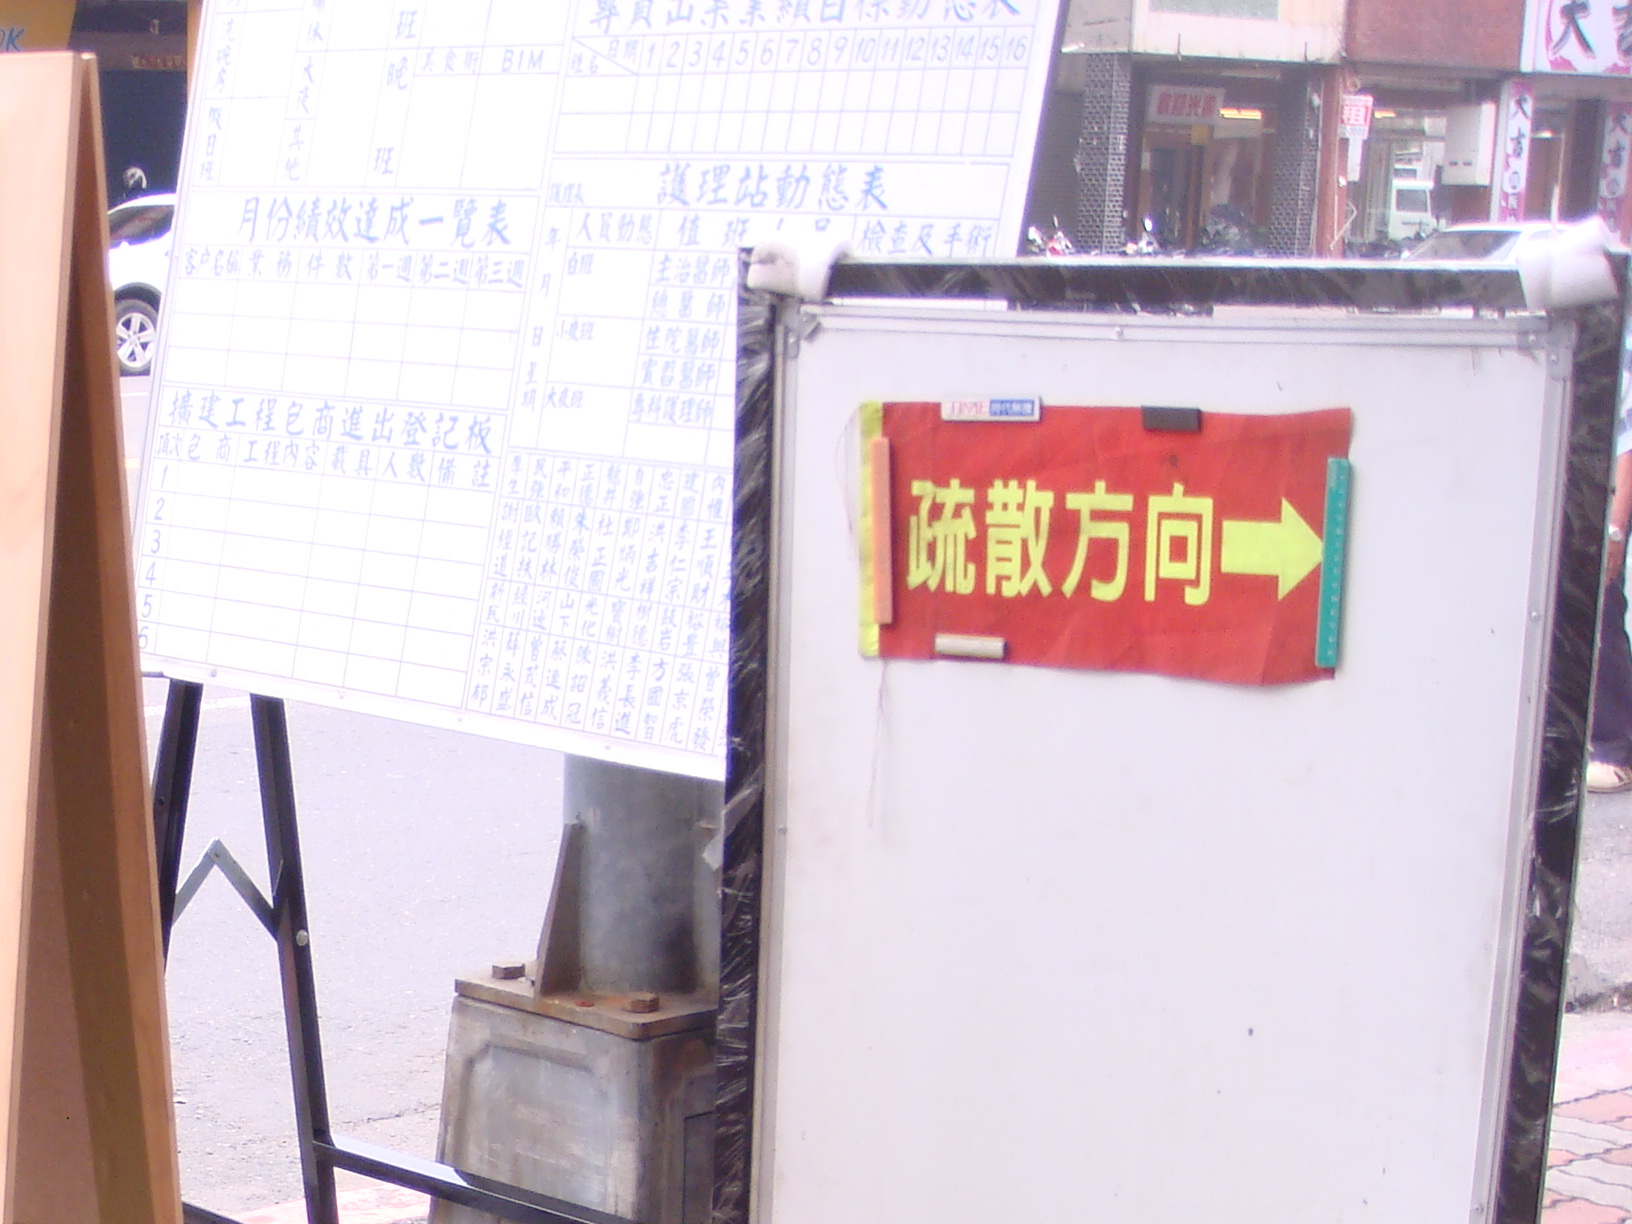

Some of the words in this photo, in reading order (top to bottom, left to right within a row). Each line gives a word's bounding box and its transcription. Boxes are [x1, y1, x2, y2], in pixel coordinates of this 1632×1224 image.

[607, 39, 639, 63] 日期
[647, 42, 656, 69] 1
[666, 40, 680, 68] 2
[688, 41, 703, 67] 3
[712, 40, 726, 67] 4
[735, 39, 751, 66] 5
[760, 39, 774, 66] 6
[787, 38, 800, 63] 7
[807, 37, 822, 66] 8
[834, 36, 848, 63] 9
[855, 36, 876, 63] 10
[881, 37, 900, 62] 11
[905, 36, 925, 62] 12
[930, 35, 951, 62] 13
[955, 35, 976, 61] 14
[980, 35, 1002, 61] 15
[1005, 35, 1029, 61] 16
[657, 162, 888, 211] 護理站動態表
[238, 196, 512, 249] 月份績效達成一覽表
[575, 212, 654, 245] 人員動態
[367, 251, 412, 283] 第一週
[420, 253, 469, 285] 第二週
[474, 255, 525, 289] 第三週
[168, 388, 492, 455] 擴建工程包商進出登記板
[243, 438, 317, 471] 工程內容
[383, 450, 426, 482] 人數
[438, 456, 490, 487] 備註
[153, 497, 165, 521] 2
[150, 529, 161, 554] 3
[906, 478, 1215, 606] 疏散方向
[145, 561, 156, 586] 4
[140, 594, 153, 619] 5
[138, 625, 149, 650] 6
